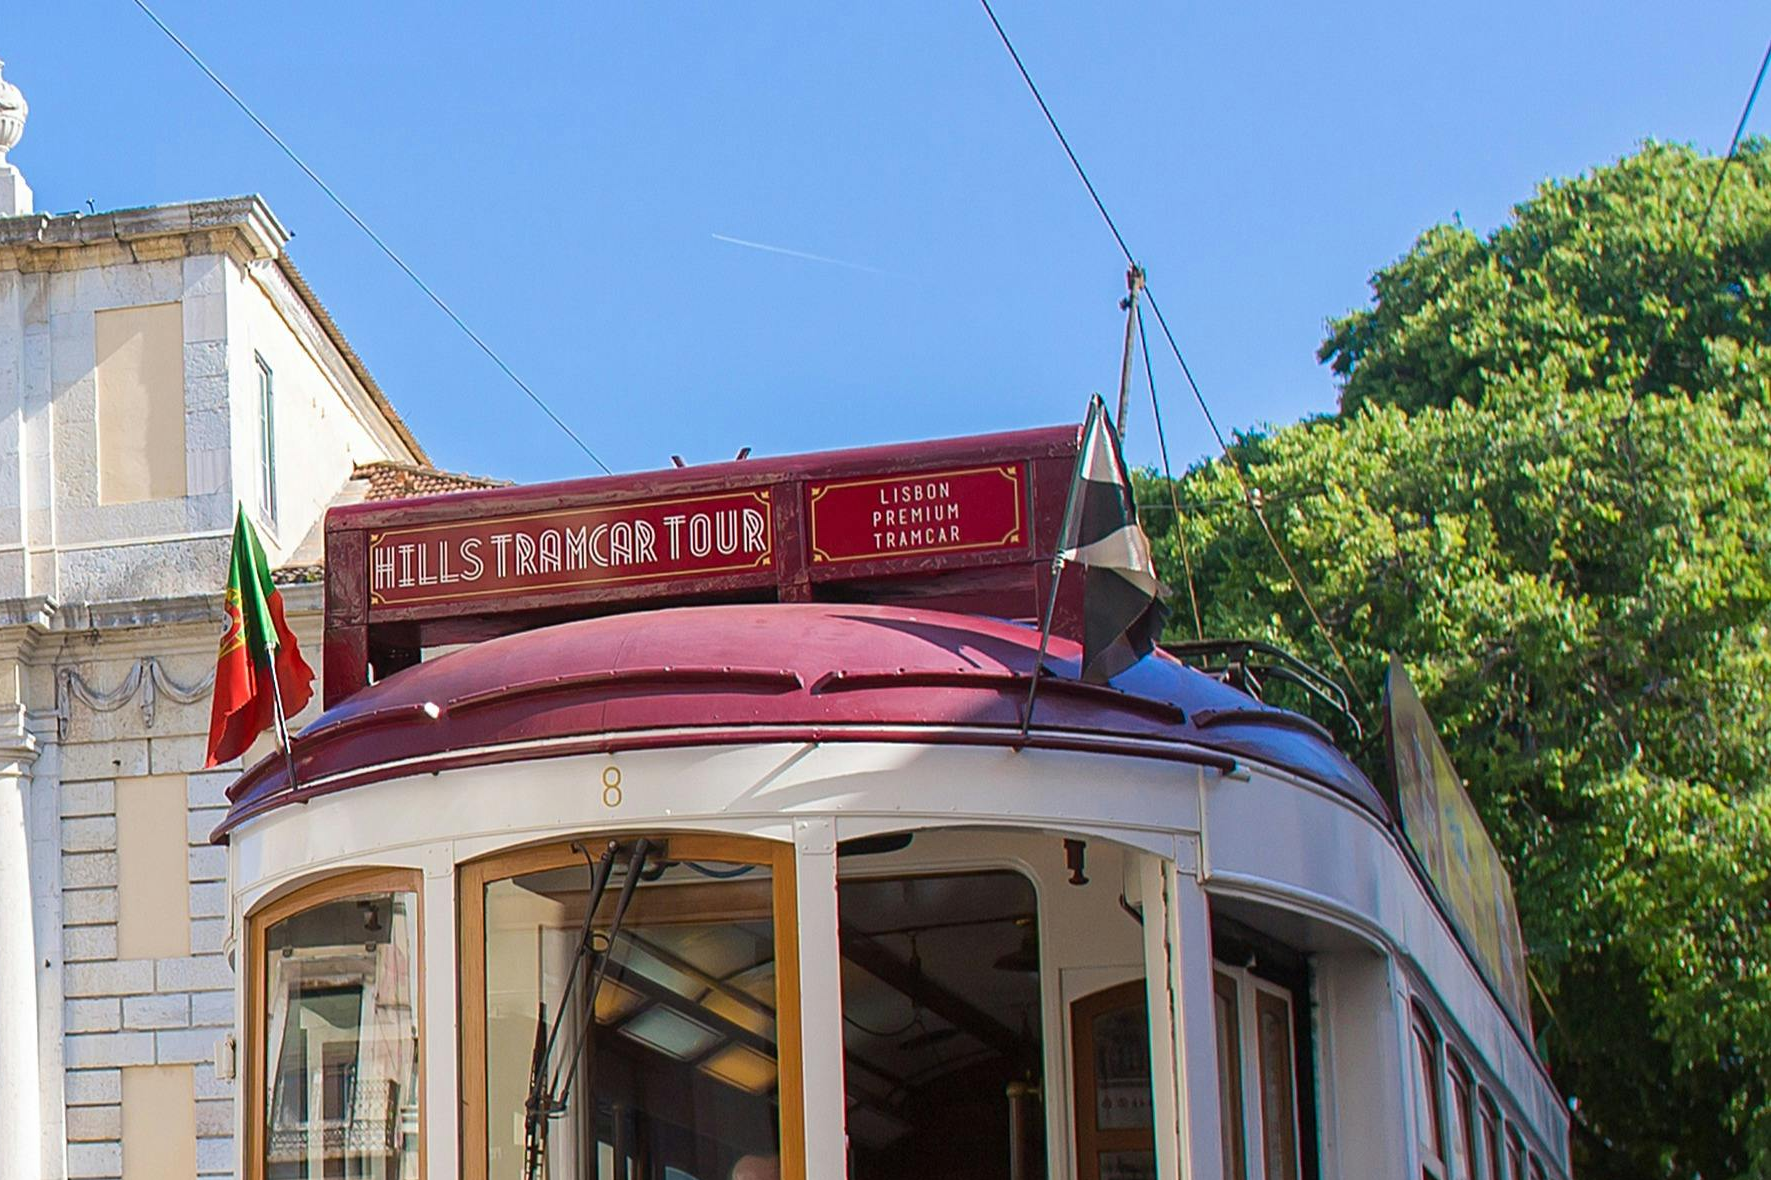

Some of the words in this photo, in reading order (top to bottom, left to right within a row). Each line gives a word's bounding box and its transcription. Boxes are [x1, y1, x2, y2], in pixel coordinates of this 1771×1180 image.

[880, 482, 949, 505] LISBON
[873, 503, 959, 528] PREMIUM
[375, 538, 484, 590] HILLS
[491, 520, 658, 577] TRAMCAR
[663, 509, 768, 561] TOUR
[873, 525, 960, 549] TRAMCAR
[602, 766, 622, 808] 8
